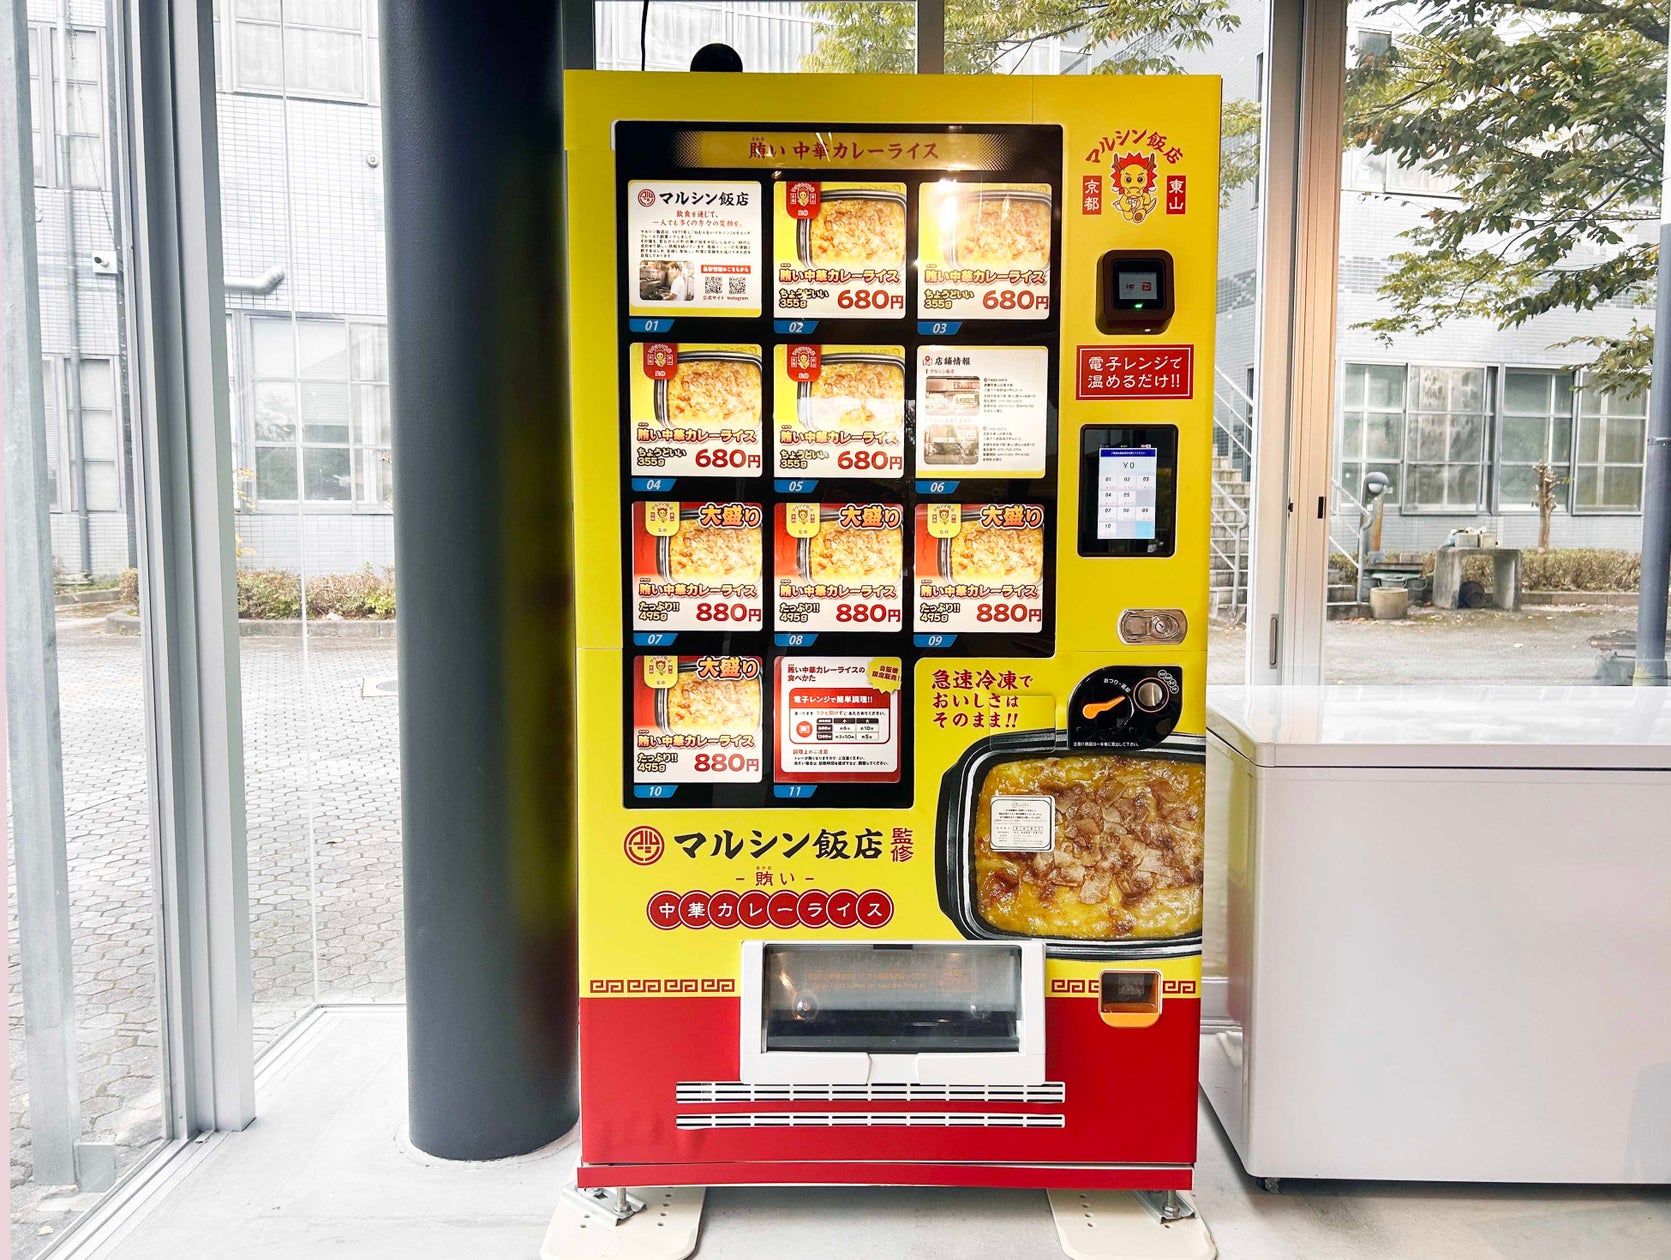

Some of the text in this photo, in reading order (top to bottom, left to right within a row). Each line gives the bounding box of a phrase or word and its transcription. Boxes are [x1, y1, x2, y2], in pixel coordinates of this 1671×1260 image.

[1085, 128, 1184, 164] マルシン飯店
[659, 191, 749, 206] マルシン飯店
[1084, 179, 1100, 211] 京都
[1168, 178, 1184, 211] 東山
[779, 289, 829, 299] ちょうどいい
[837, 290, 904, 309] 680円
[924, 289, 974, 299] ちょうどいい
[779, 299, 807, 308] 355g
[924, 299, 952, 309] 355g
[982, 290, 1048, 310] 680円
[644, 320, 659, 331] 01
[789, 322, 804, 333] 02
[933, 323, 947, 334] 03
[1088, 356, 1182, 371] 電子レンジで
[1088, 374, 1180, 388] 温めるだけ!!
[637, 447, 686, 457] ちょうどいい
[780, 450, 829, 460] ちょうどいい
[637, 457, 665, 466] 355g
[695, 449, 760, 468] 680円
[837, 451, 902, 470] 680円
[780, 460, 807, 469] 355g
[647, 480, 661, 490] 04
[789, 481, 803, 491] 05
[930, 482, 944, 492] 06
[700, 504, 761, 528] 大盛り
[840, 505, 901, 528] 大盛り
[982, 505, 1041, 528] 大盛り
[639, 601, 680, 612] たっぷり!!
[780, 602, 820, 613] たっぷり!!
[920, 603, 960, 613] たっぷり!!
[639, 612, 668, 621] 495g
[696, 603, 761, 622] 880円
[780, 613, 808, 622] 495g
[836, 604, 900, 622] 880円
[920, 613, 948, 622] 495g
[976, 604, 1041, 622] 880円
[648, 634, 662, 644] 07
[789, 635, 803, 645] 08
[928, 636, 942, 646] 09
[698, 657, 758, 678] 大盛り
[932, 669, 1033, 690] 急速冷凍で
[932, 692, 1018, 708] おいしさは
[932, 712, 1018, 728] そのまま!!
[637, 753, 678, 763] たっぷり!!
[694, 754, 759, 772] 880円
[637, 763, 666, 772] 495g
[650, 786, 661, 796] 10
[790, 786, 801, 796] 11
[674, 828, 883, 860] マルシン飯店
[890, 827, 914, 862] 監修
[658, 902, 883, 918] 中華カレーライス
